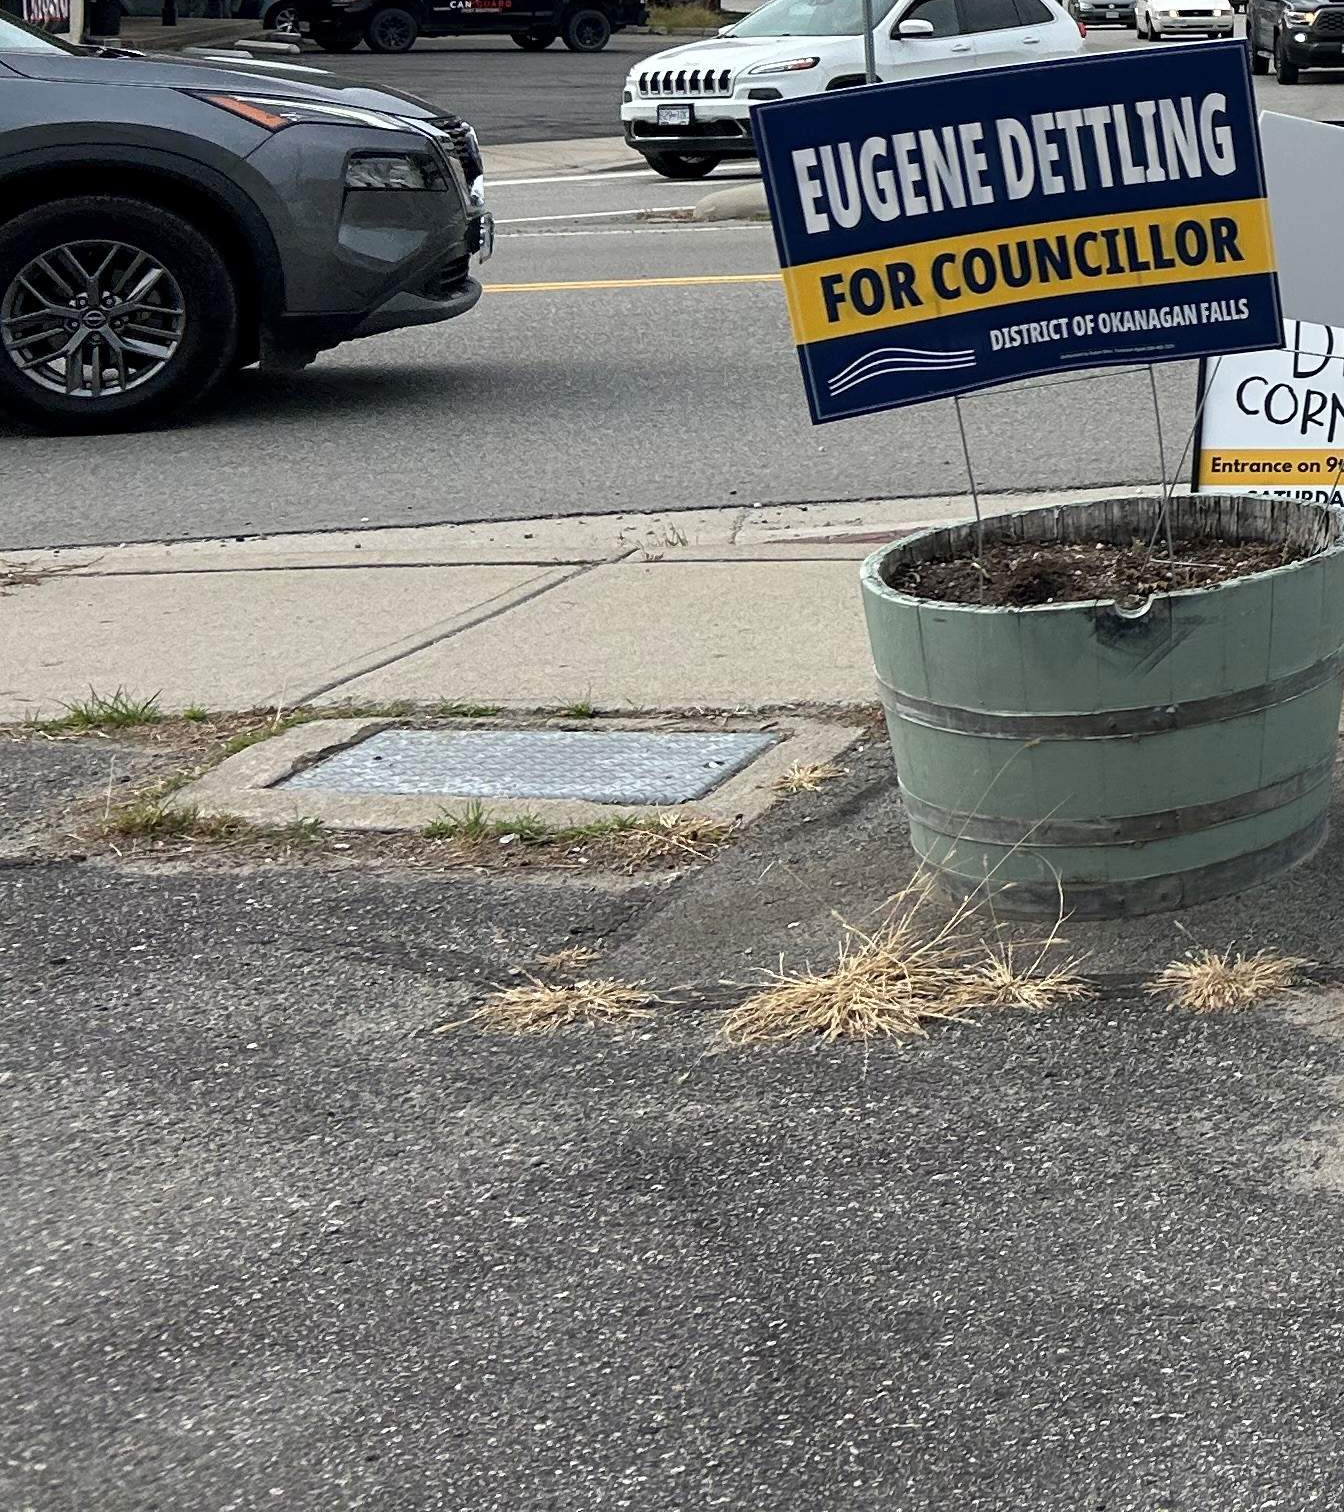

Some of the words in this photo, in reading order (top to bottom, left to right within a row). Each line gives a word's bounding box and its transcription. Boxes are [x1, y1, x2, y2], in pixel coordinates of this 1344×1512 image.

[791, 122, 994, 234] EUGENE
[994, 92, 1237, 201] DETTLING
[820, 262, 922, 323] FOR
[931, 217, 1245, 300] COUNCILLOR
[990, 317, 1068, 352] DISTRICT
[1073, 315, 1095, 337] OF
[1098, 306, 1198, 333] OKANAGAN
[1201, 298, 1249, 324] FALLS
[1211, 457, 1292, 474] Entrance
[1298, 462, 1320, 473] on
